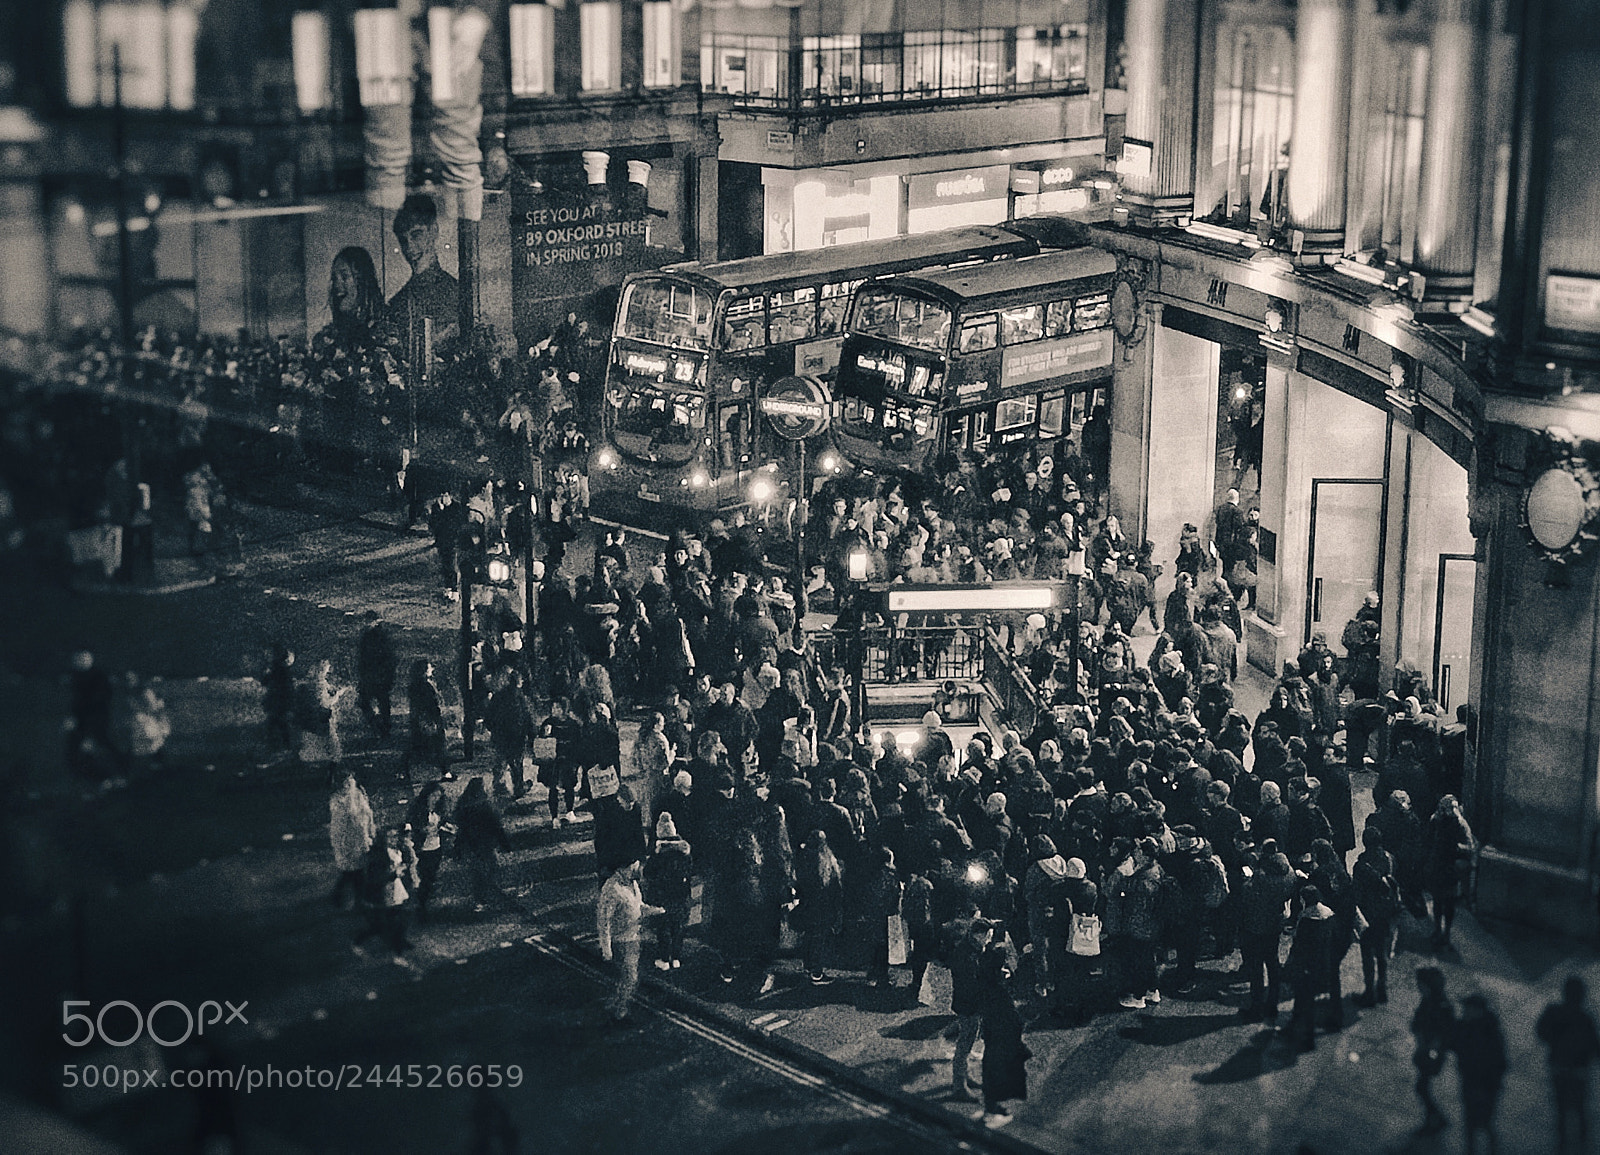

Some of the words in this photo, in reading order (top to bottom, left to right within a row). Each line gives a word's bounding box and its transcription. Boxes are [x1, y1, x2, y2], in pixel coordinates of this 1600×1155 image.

[526, 209, 548, 226] SEE
[551, 207, 579, 222] YOU
[582, 205, 598, 219] AT
[526, 231, 543, 247] 89
[546, 225, 604, 245] OXFORD
[526, 252, 541, 267] IN
[544, 246, 591, 265] SPRING
[594, 242, 622, 258] 2018
[674, 362, 695, 381] 23
[762, 400, 822, 416] UNDERGROUND
